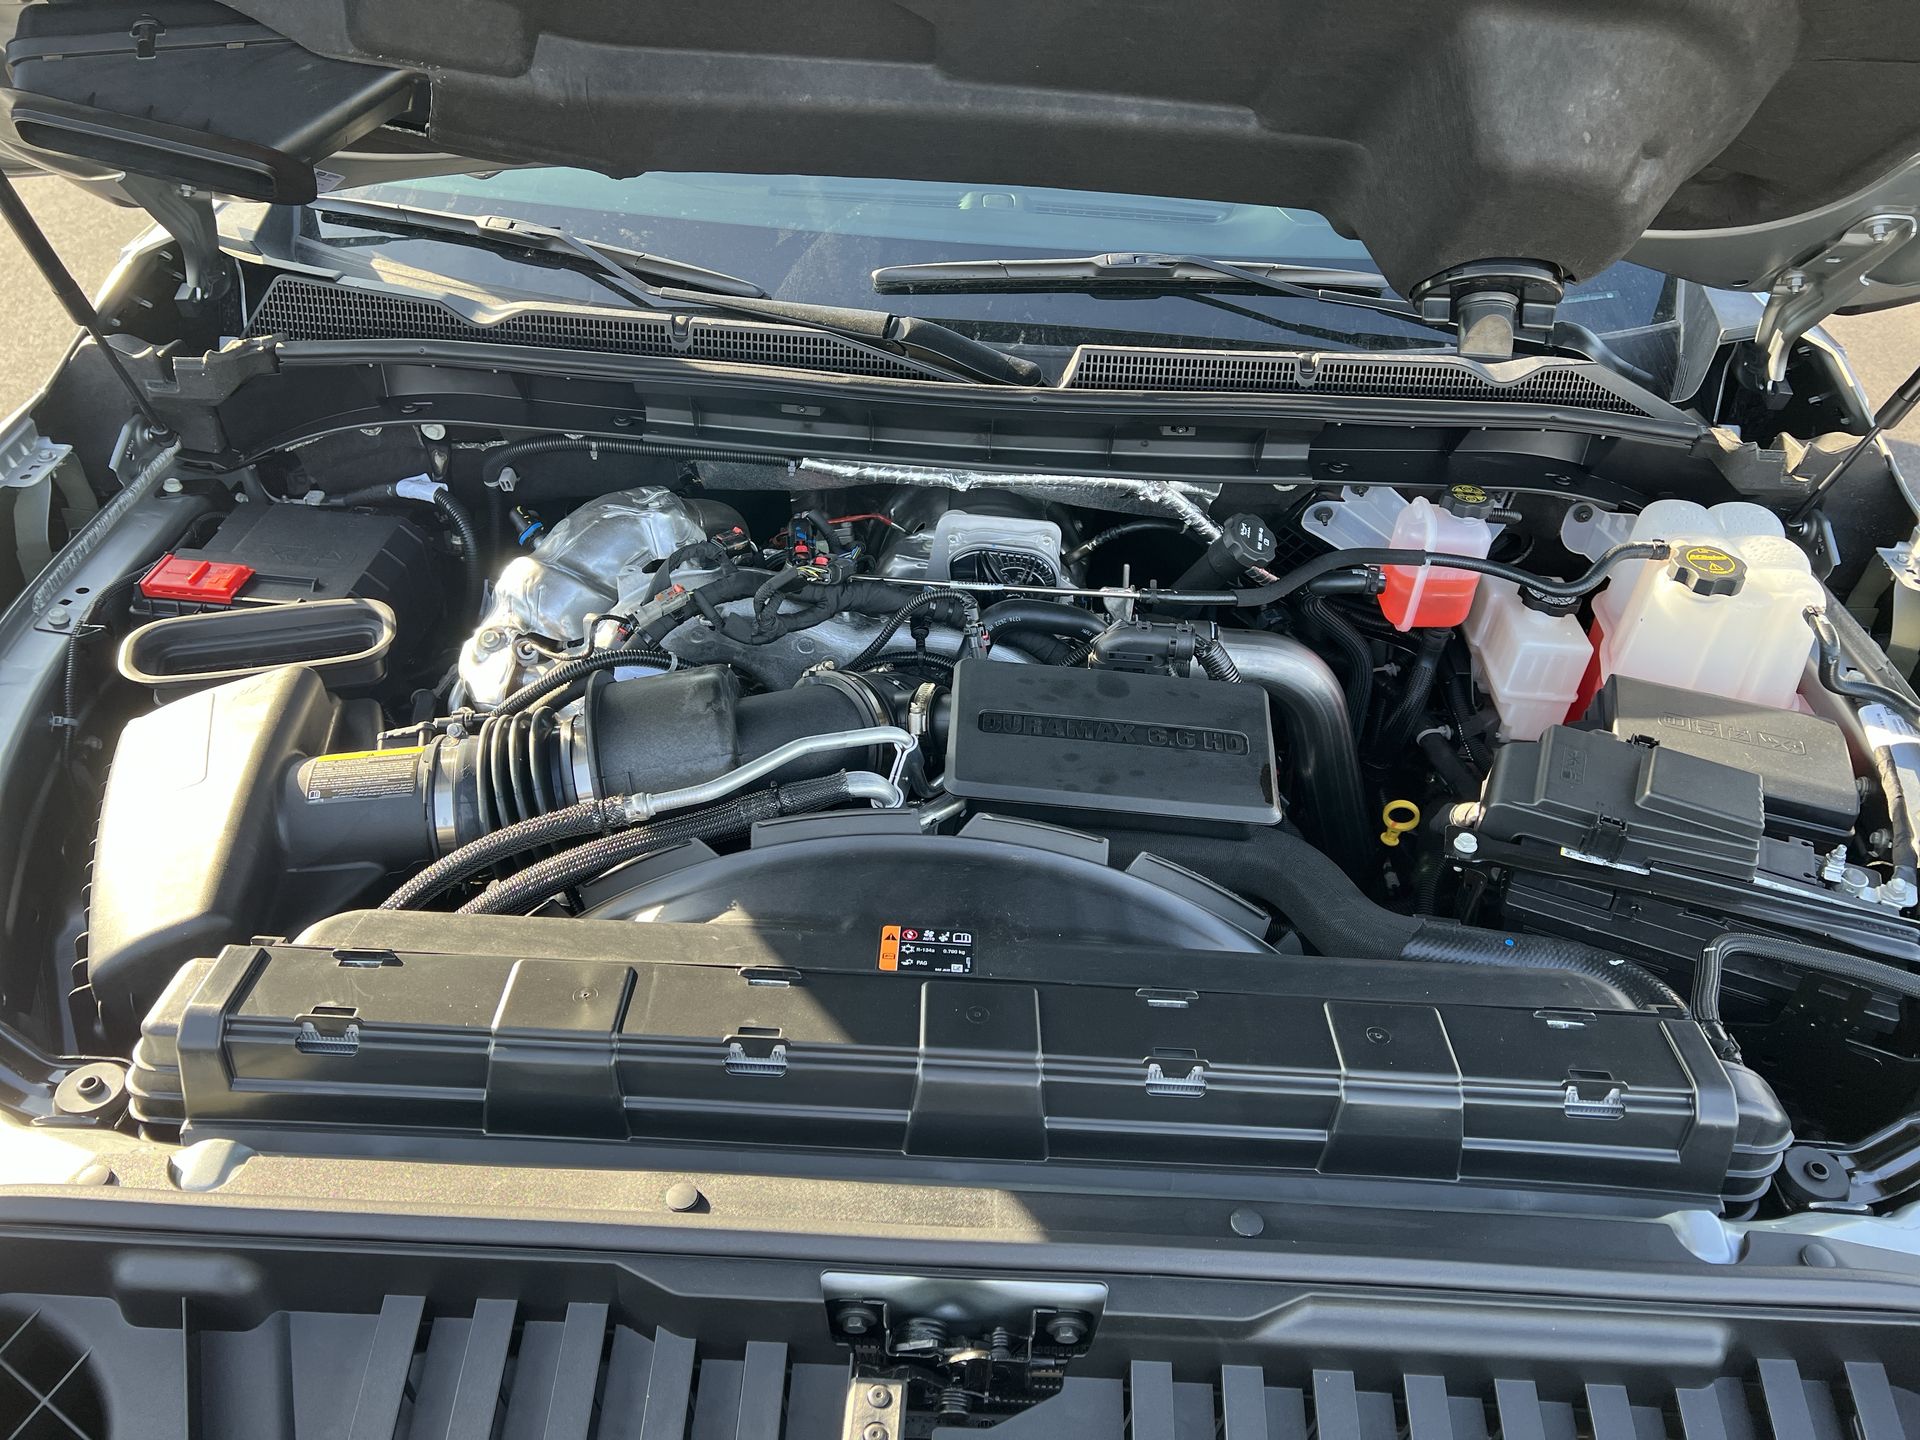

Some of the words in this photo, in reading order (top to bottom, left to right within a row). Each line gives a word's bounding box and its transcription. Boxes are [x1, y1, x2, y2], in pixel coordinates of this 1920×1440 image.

[983, 713, 1136, 744] DURAMAX
[1147, 728, 1195, 748] 6.6
[1203, 731, 1245, 753] HD
